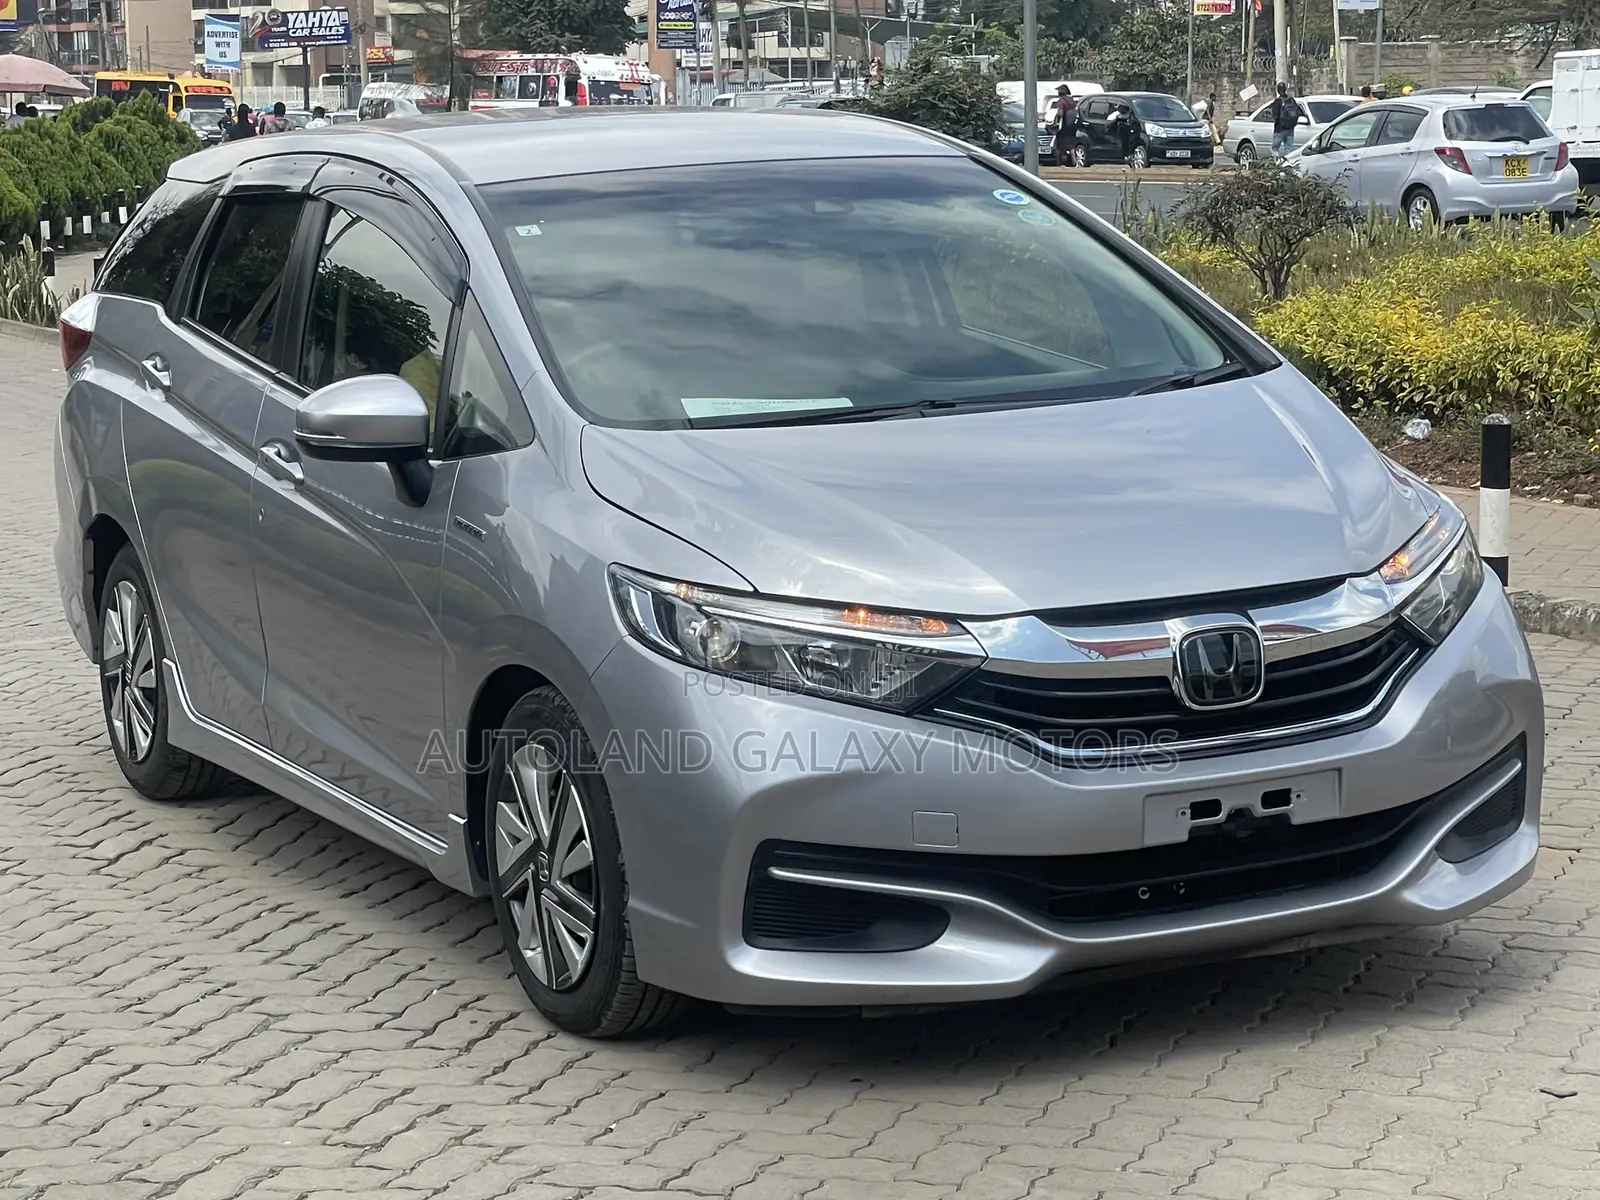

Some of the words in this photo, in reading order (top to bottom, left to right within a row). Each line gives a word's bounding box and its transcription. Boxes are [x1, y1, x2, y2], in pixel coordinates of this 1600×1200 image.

[286, 10, 341, 29] YAHYA
[206, 30, 239, 39] ADVERTISE
[288, 28, 310, 37] CAR
[311, 26, 346, 36] SALES
[214, 41, 231, 49] WITH
[218, 51, 228, 59] US
[1504, 158, 1521, 168] KCX
[1504, 168, 1528, 177] 083E
